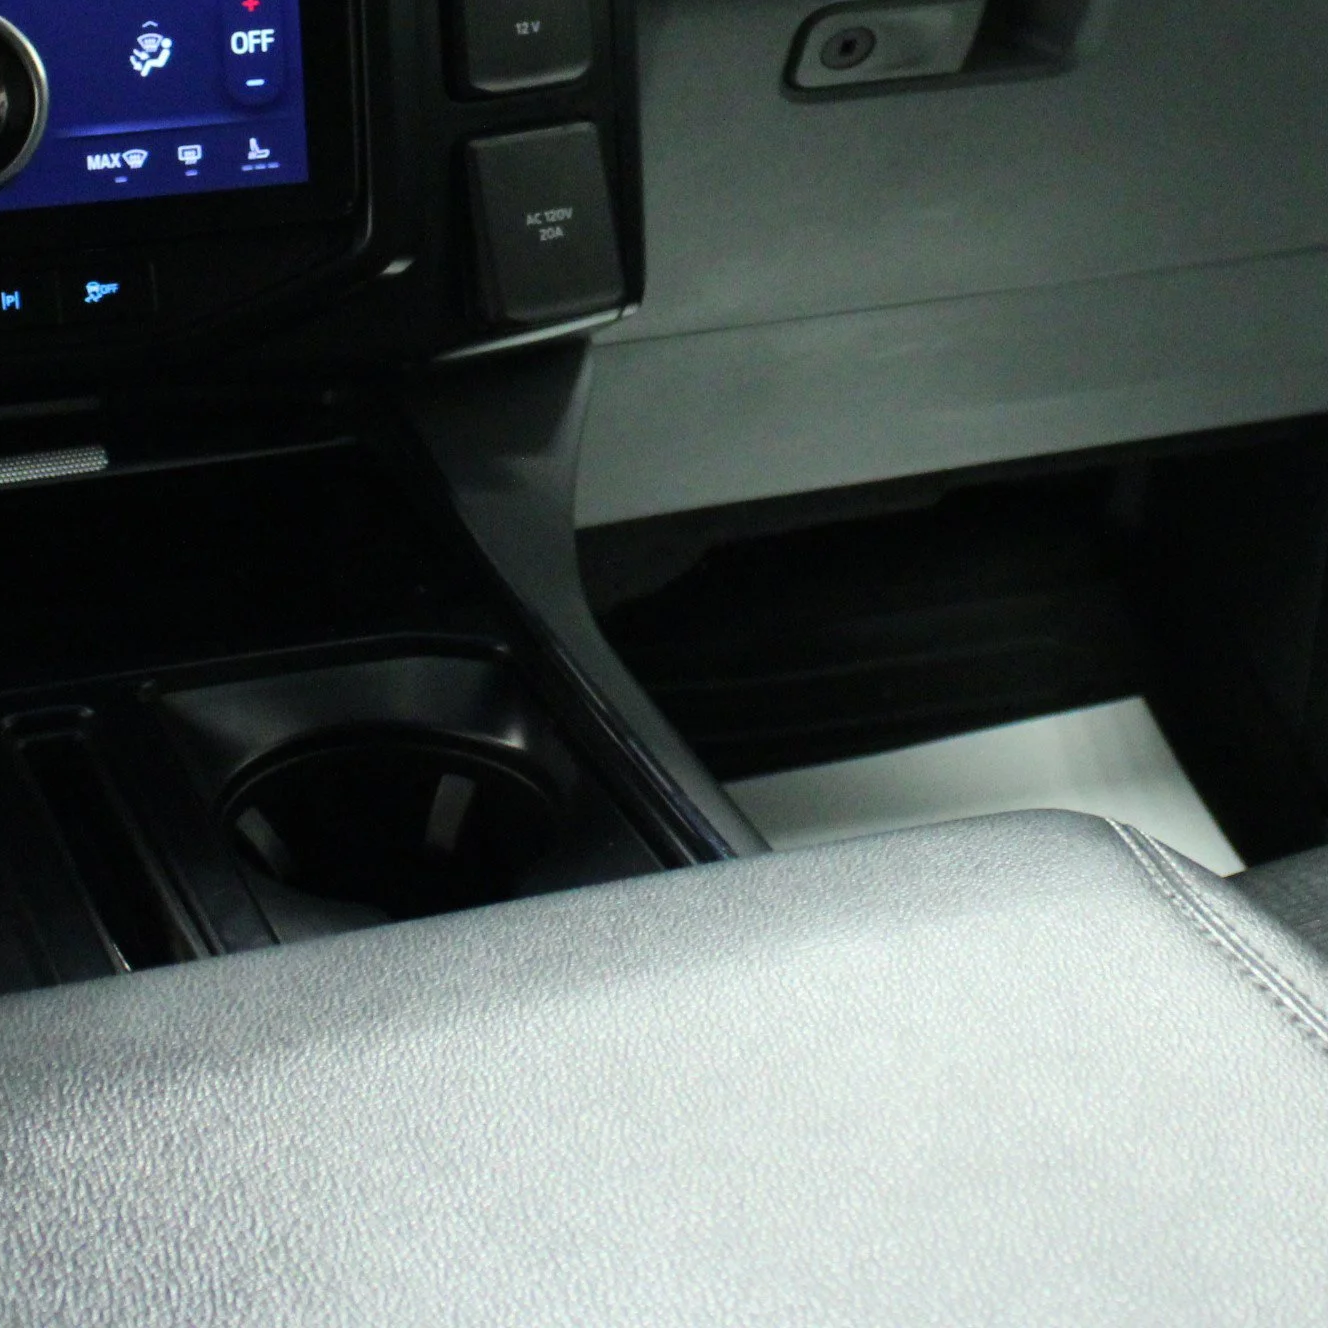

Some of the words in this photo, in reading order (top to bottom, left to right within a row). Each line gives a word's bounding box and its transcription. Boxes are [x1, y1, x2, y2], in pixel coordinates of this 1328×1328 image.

[230, 28, 275, 55] OFF
[86, 152, 122, 171] MAX
[100, 282, 119, 295] OFF
